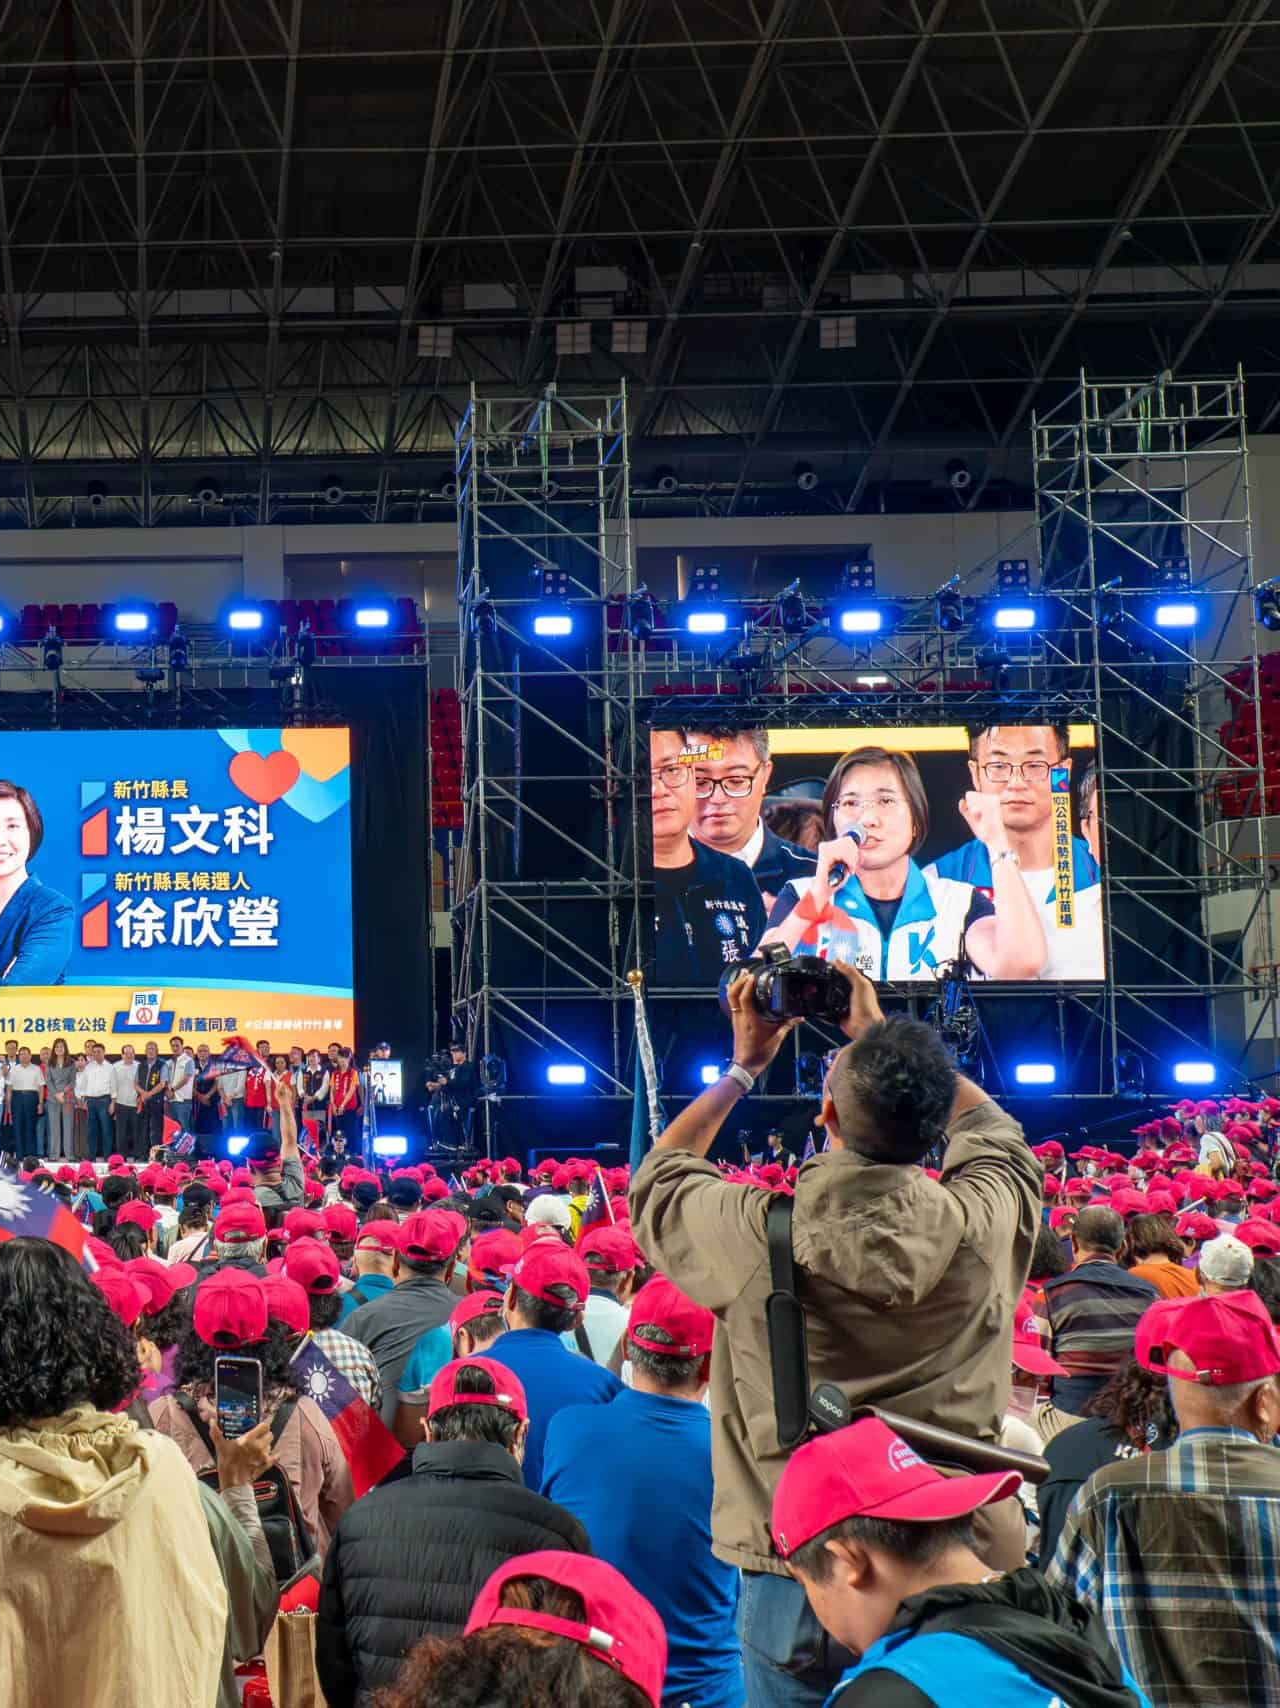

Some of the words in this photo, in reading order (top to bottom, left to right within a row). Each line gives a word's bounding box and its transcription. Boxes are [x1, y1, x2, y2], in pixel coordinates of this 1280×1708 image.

[113, 780, 189, 799] 新竹縣長
[114, 804, 274, 856] 楊文科
[114, 871, 251, 891] 新竹縣長候選人
[114, 896, 279, 948] 徐欣瑩
